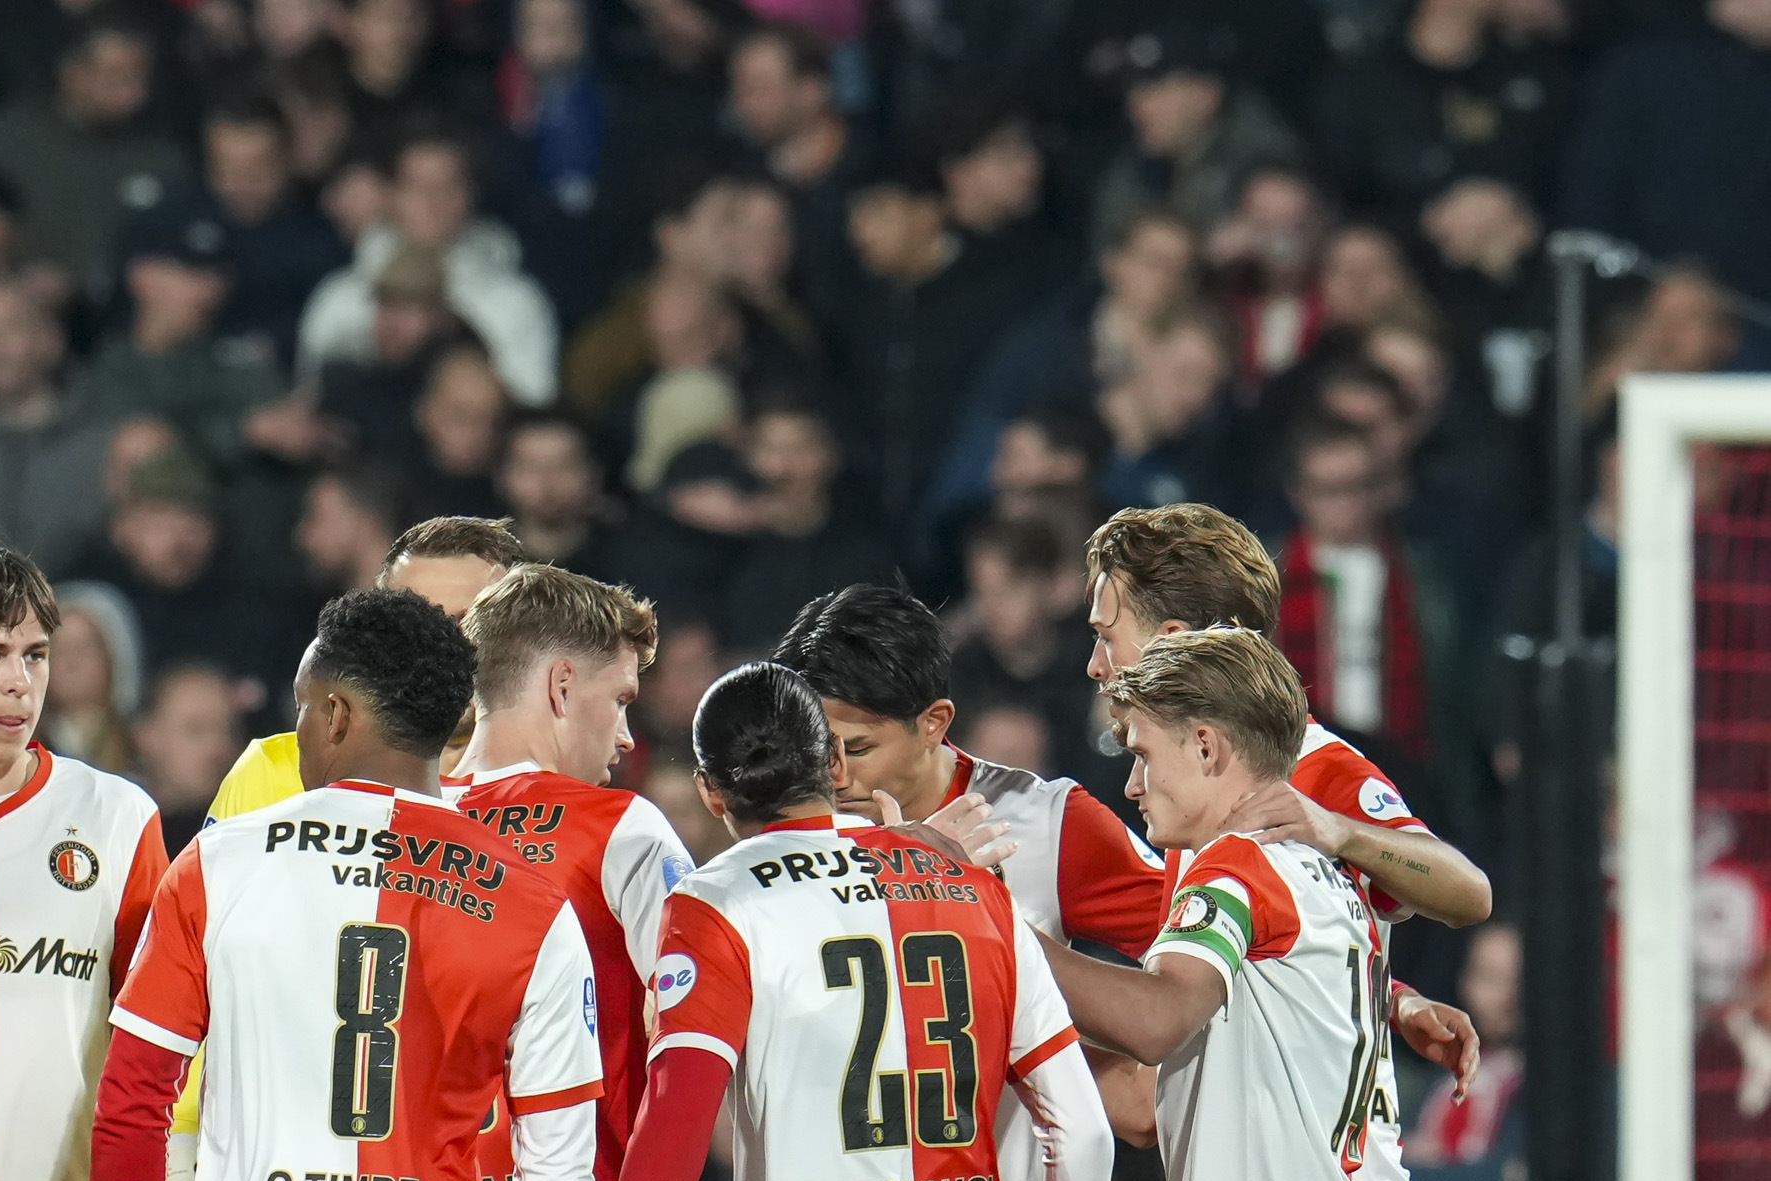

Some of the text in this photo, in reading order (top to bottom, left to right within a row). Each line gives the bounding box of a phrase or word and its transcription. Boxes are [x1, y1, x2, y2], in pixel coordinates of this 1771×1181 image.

[265, 820, 506, 891] PRIJSVRIJ
[750, 846, 964, 889] PRIJSVRIJ
[332, 862, 495, 922] vakanties
[832, 878, 979, 904] vakanties
[13, 937, 99, 981] Markt
[328, 920, 411, 1142] 8
[819, 930, 980, 1155] 23
